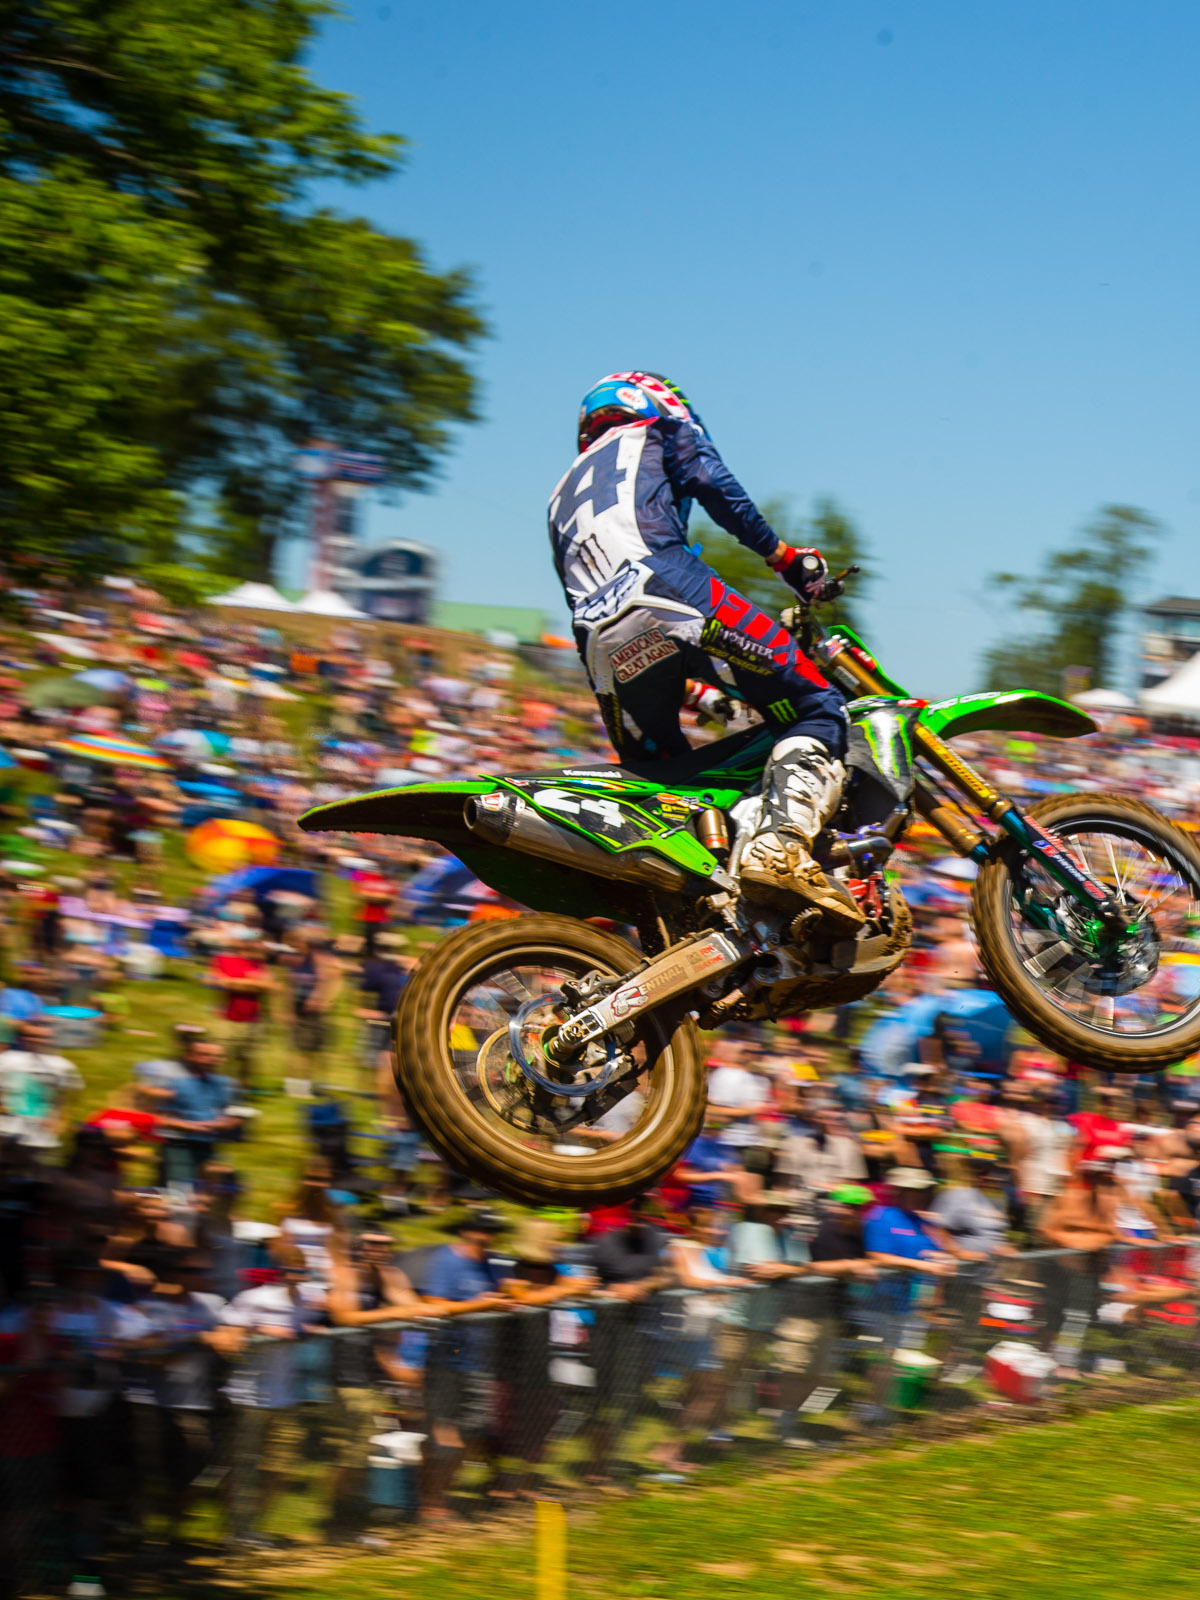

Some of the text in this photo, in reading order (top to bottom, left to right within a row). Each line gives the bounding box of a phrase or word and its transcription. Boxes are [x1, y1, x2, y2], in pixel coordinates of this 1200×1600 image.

[610, 636, 655, 669] AMERICA
[616, 641, 679, 682] GREAT AGAIN
